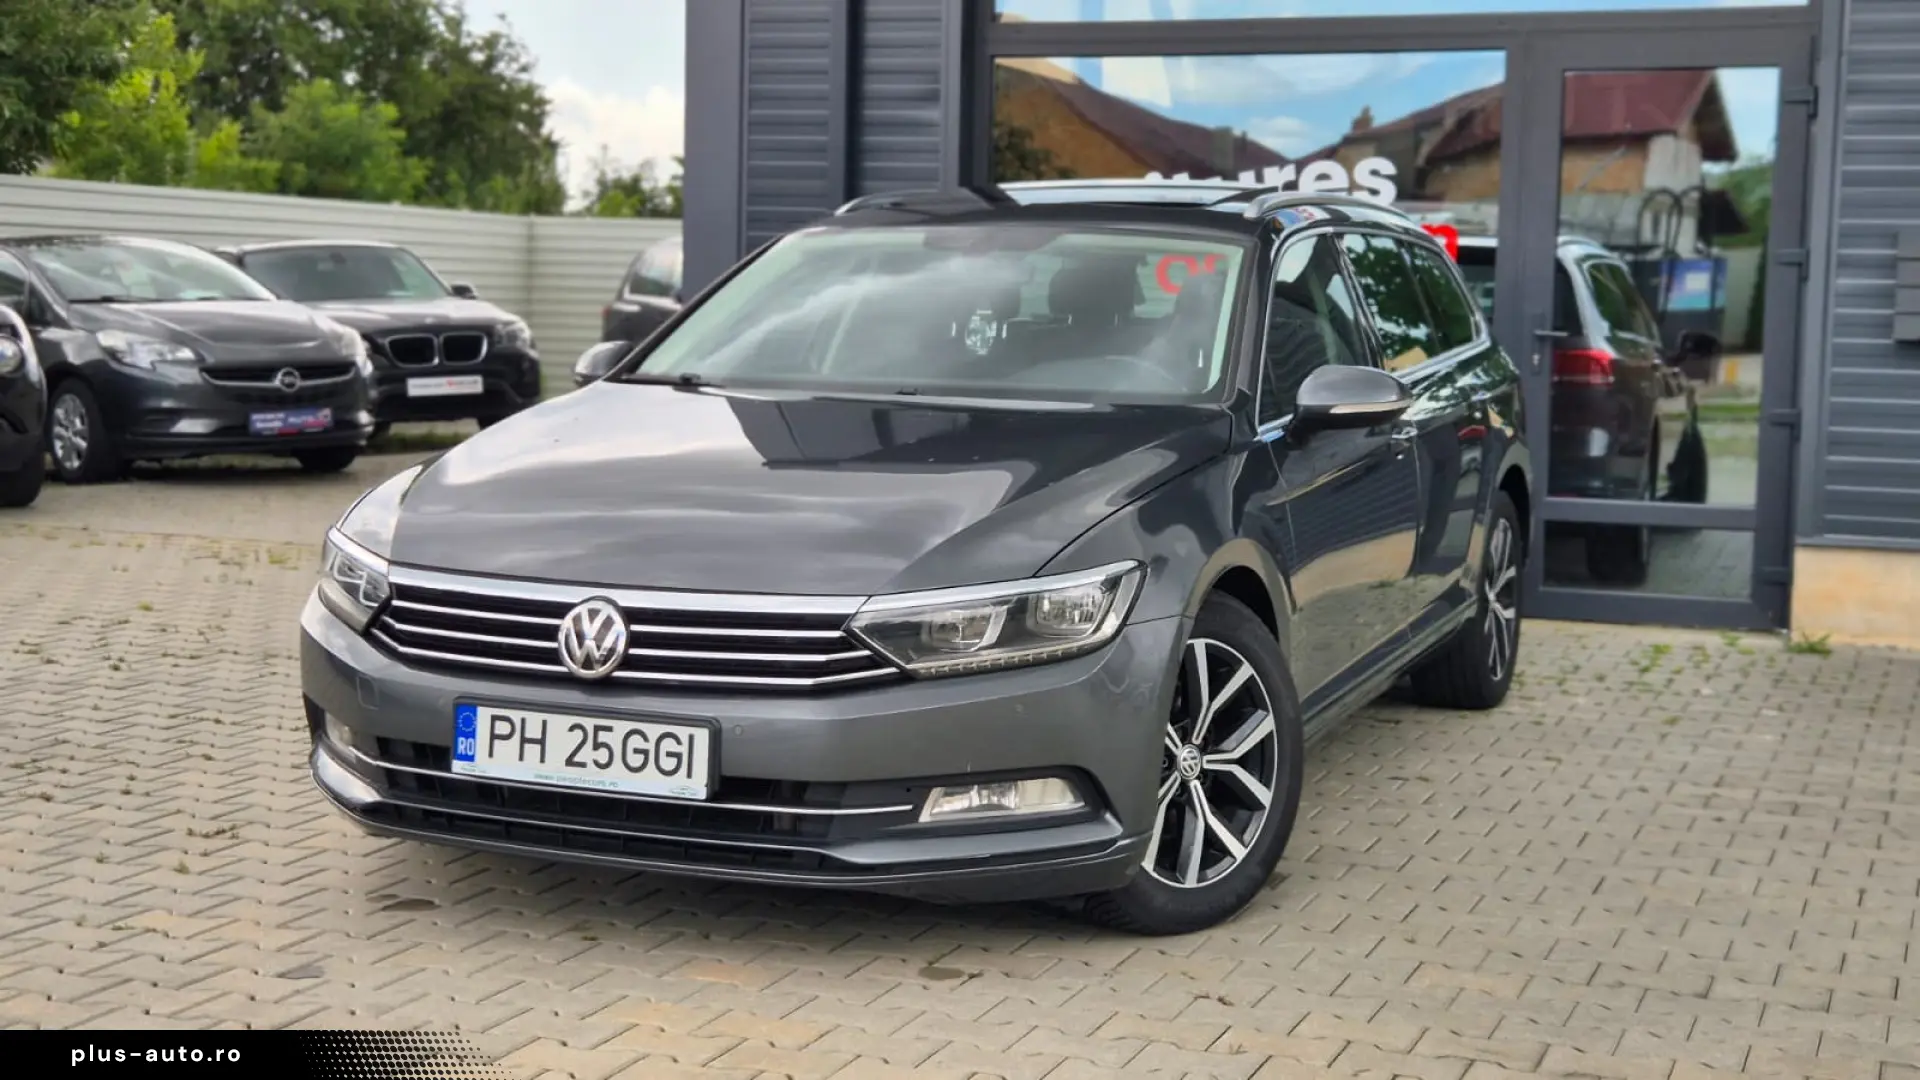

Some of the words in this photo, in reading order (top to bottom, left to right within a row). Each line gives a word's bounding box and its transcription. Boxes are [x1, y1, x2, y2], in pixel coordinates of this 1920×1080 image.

[457, 736, 475, 756] RO
[488, 714, 548, 764] PH
[565, 722, 695, 779] 25GGI
